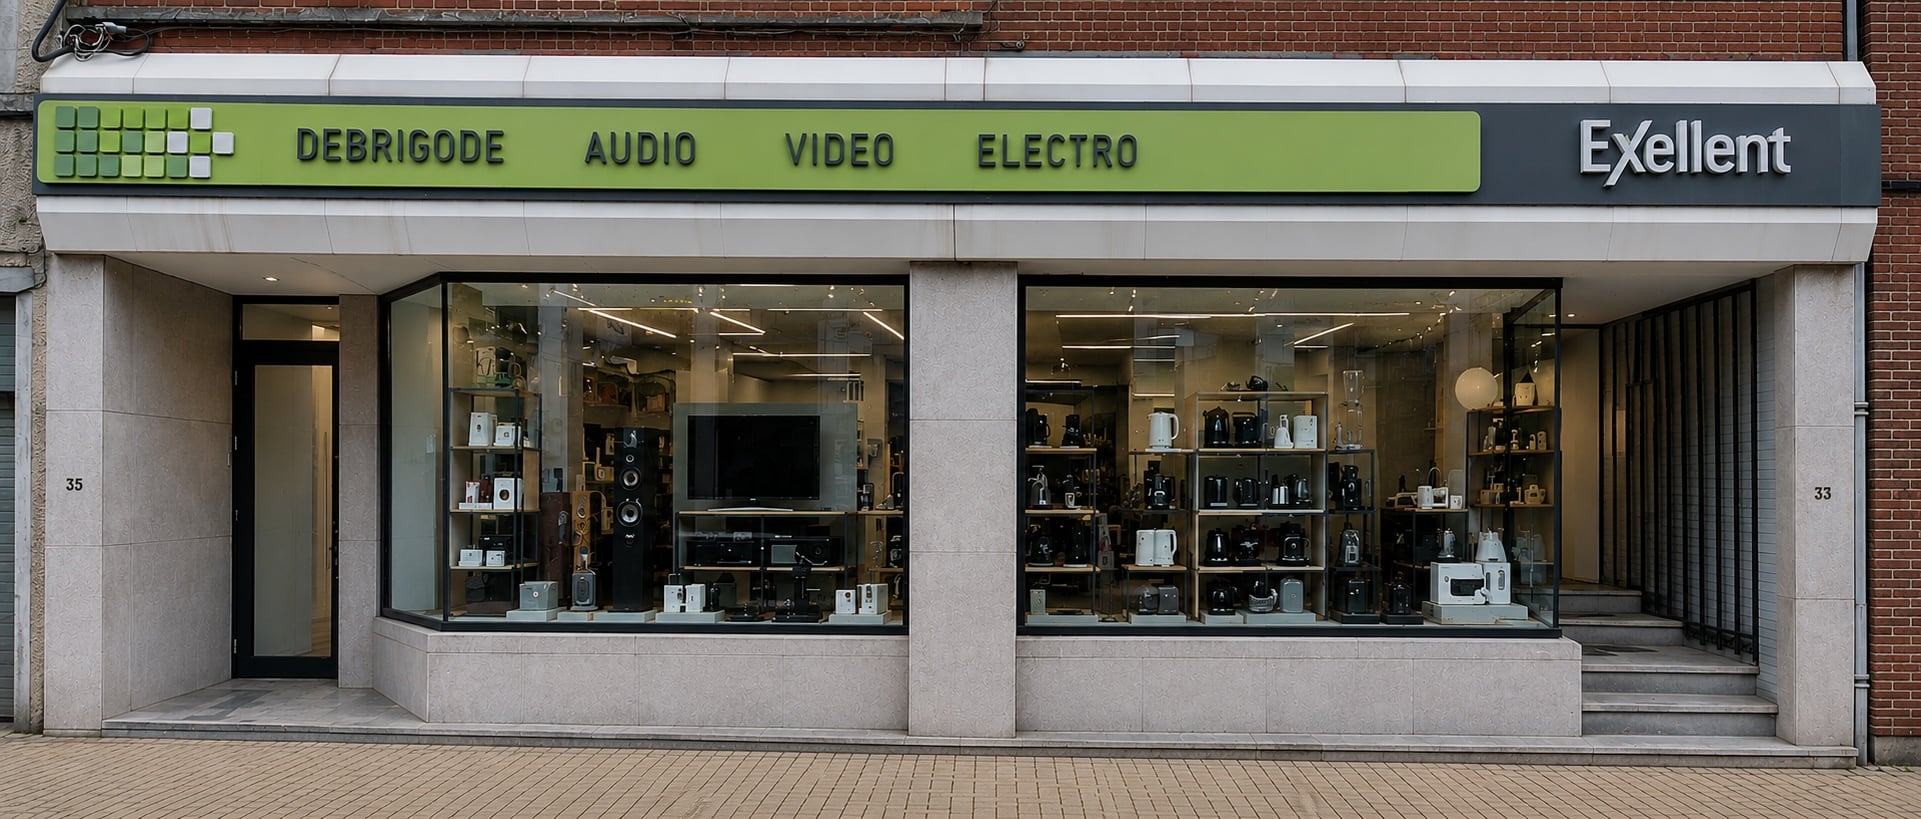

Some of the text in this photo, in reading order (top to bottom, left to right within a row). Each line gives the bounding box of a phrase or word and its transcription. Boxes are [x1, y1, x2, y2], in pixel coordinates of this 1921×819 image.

[296, 127, 1139, 169] DEBRIGODE AUDIO VIDEO ELECTRO
[66, 478, 83, 491] 35
[1814, 486, 1832, 500] 33
